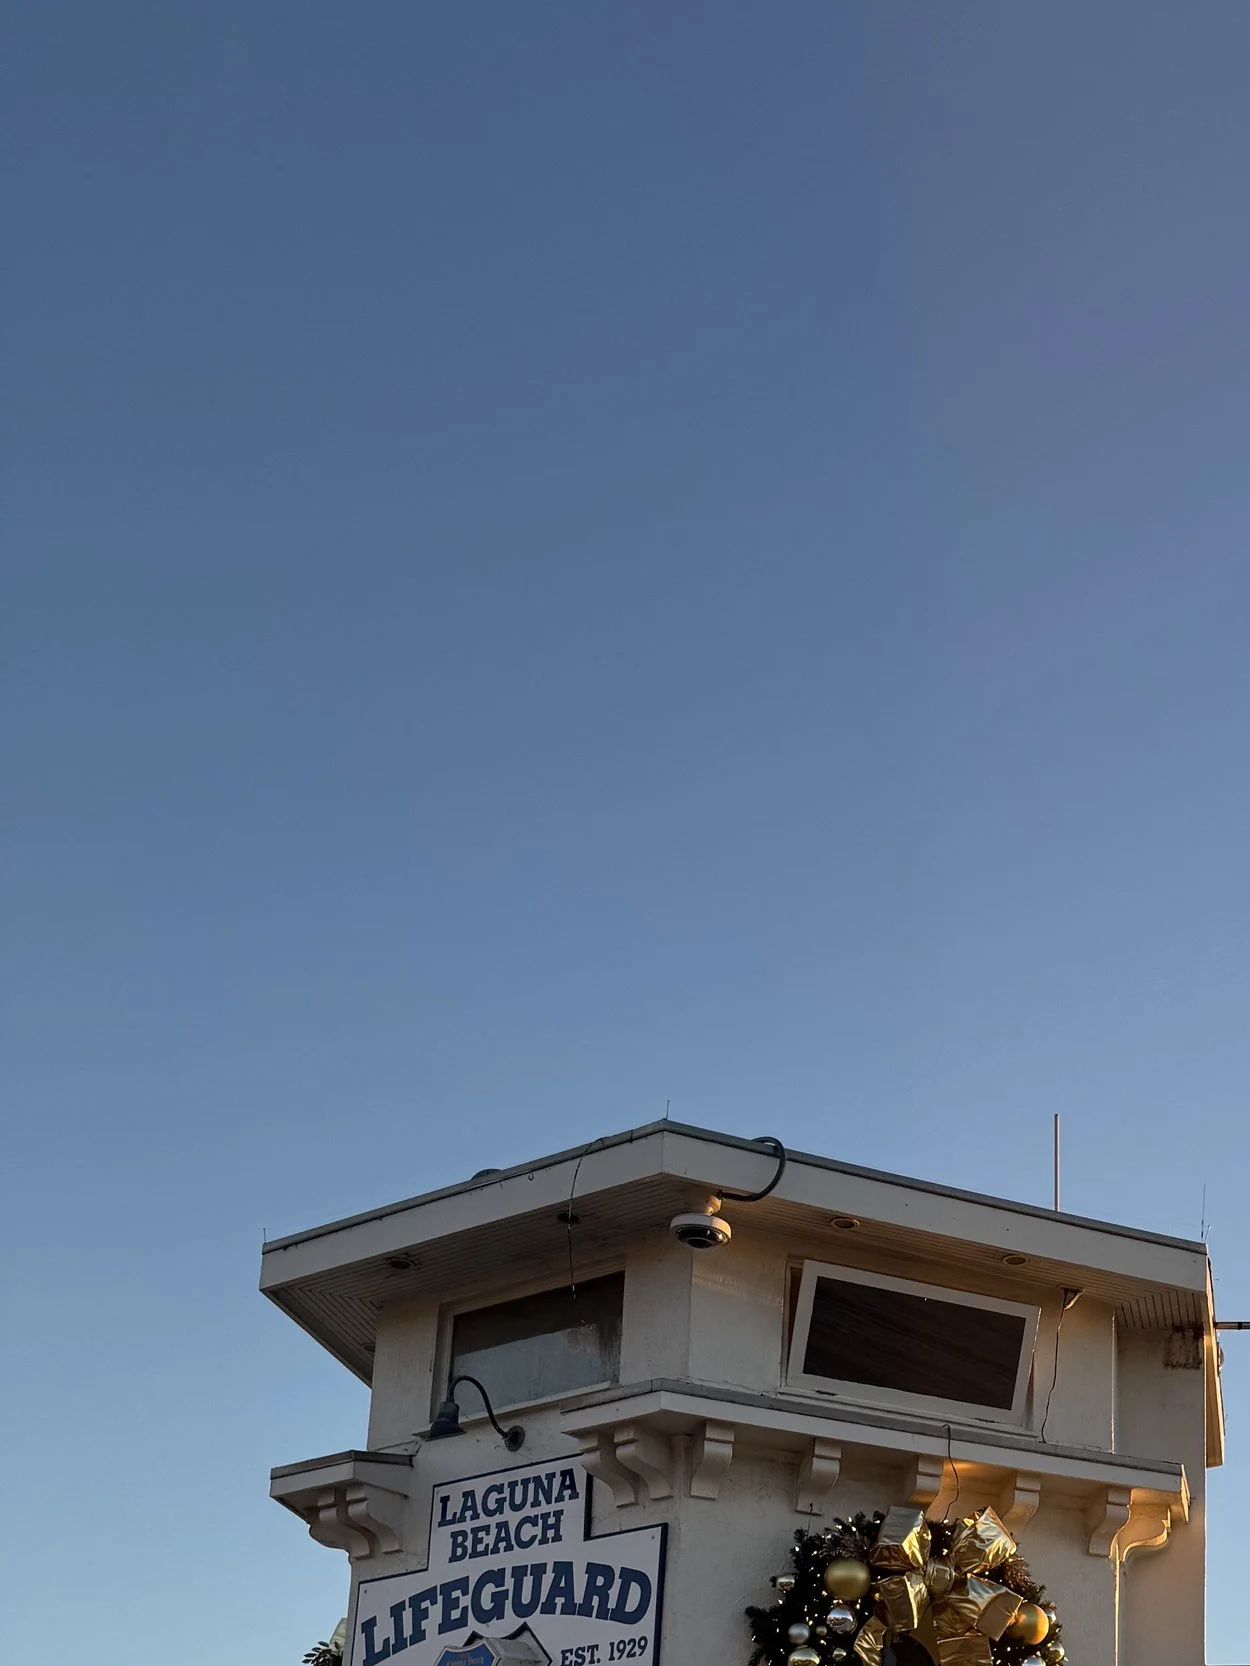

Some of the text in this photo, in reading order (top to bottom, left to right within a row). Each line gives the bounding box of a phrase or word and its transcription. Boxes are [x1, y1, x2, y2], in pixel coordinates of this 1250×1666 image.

[438, 1468, 579, 1528] LAGUNA
[449, 1509, 564, 1563] BEACH
[608, 1636, 649, 1662] 1929
